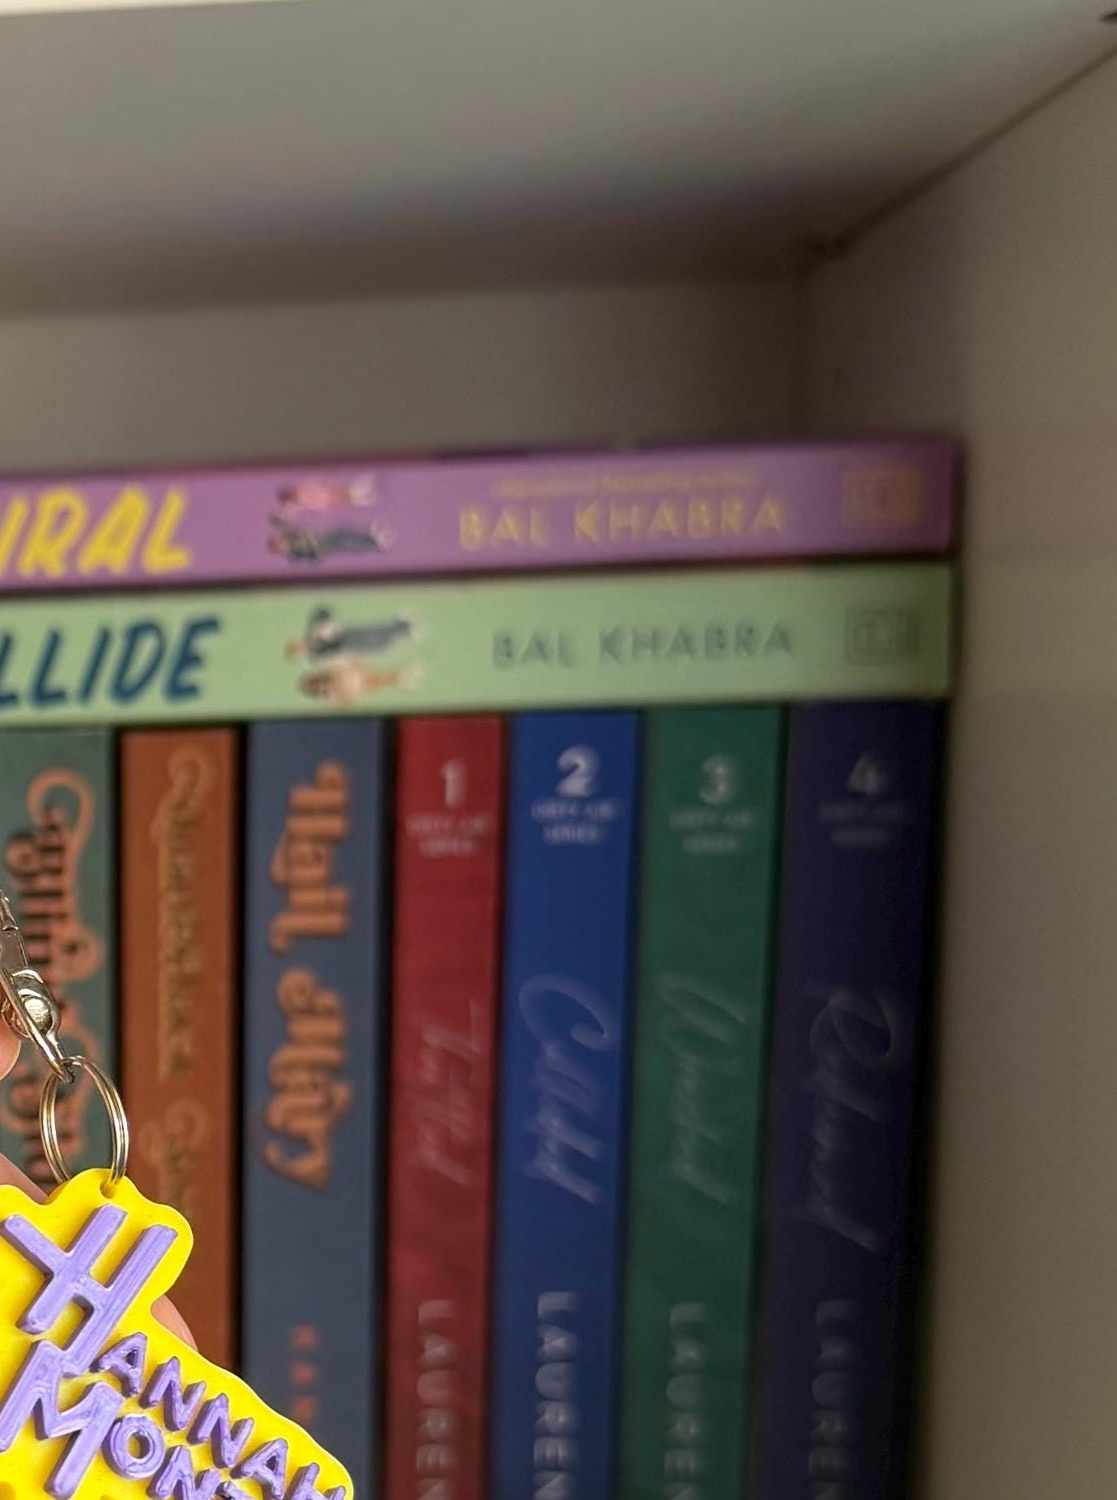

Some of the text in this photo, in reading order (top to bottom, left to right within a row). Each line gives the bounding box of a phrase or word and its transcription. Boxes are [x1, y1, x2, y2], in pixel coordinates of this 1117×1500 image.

[459, 495, 783, 551] BAL KHABRA
[492, 620, 793, 669] BAL KHABRA
[441, 758, 465, 807] 1
[557, 745, 599, 798] 2
[697, 755, 738, 803] 3
[847, 750, 883, 796] 4
